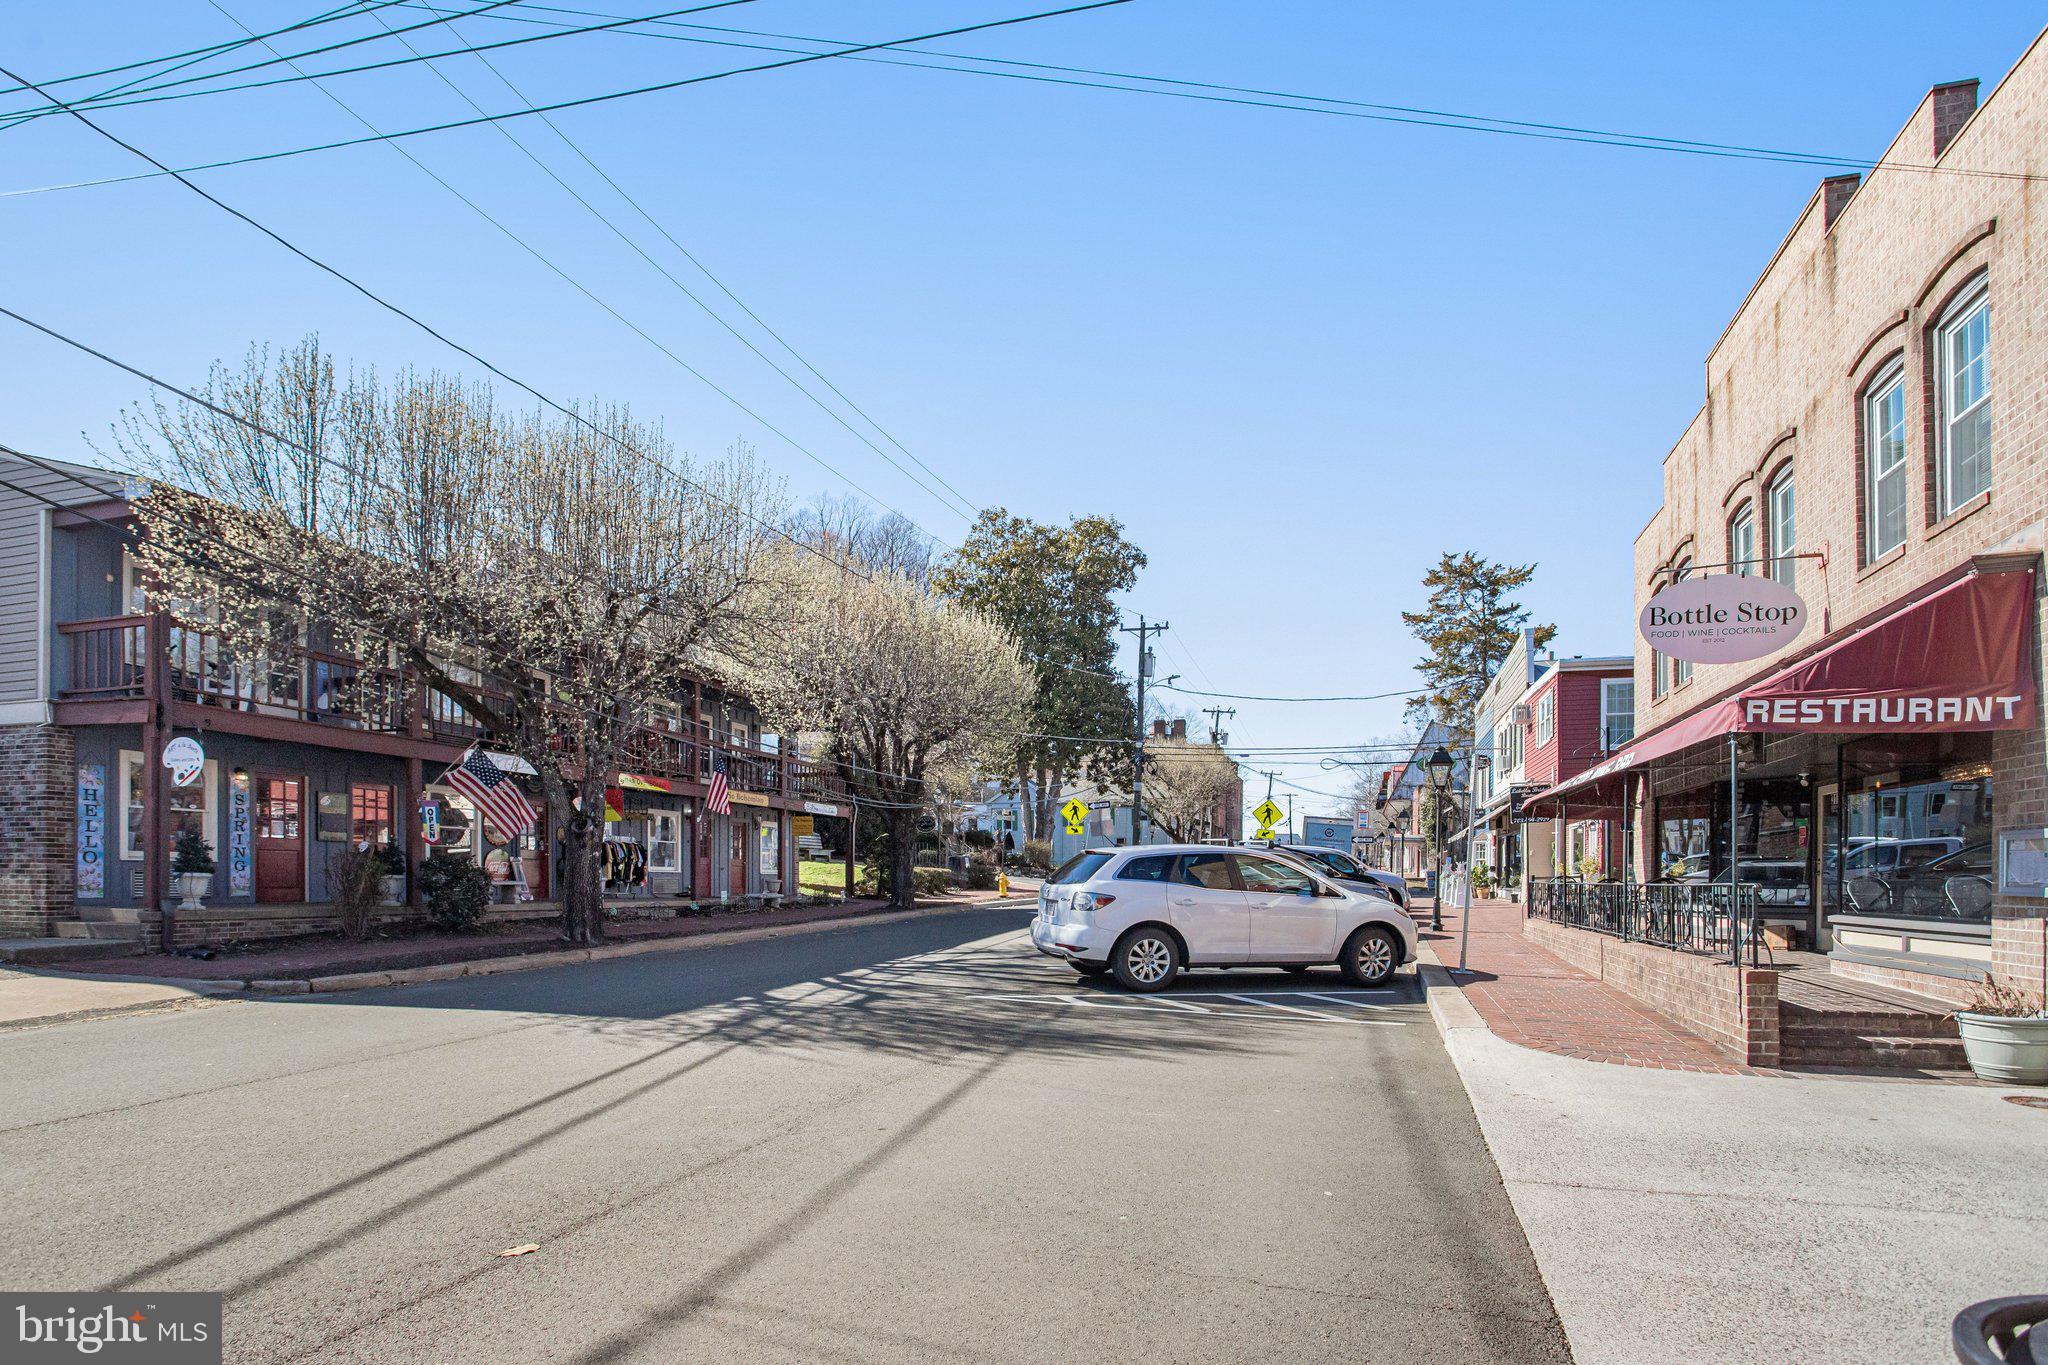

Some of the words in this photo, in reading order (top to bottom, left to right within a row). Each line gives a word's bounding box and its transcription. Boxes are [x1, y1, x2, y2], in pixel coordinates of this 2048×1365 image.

[1649, 603, 1729, 627] Bottle
[1737, 601, 1798, 625] Stop
[1650, 630, 1680, 639] FOOD
[1687, 628, 1714, 637] WINE
[1721, 625, 1777, 636] COCKTAILS
[1746, 695, 2021, 724] RESTAURANT
[82, 788, 98, 864] HELLO
[233, 793, 247, 872] SPRING
[426, 808, 436, 839] OPEN
